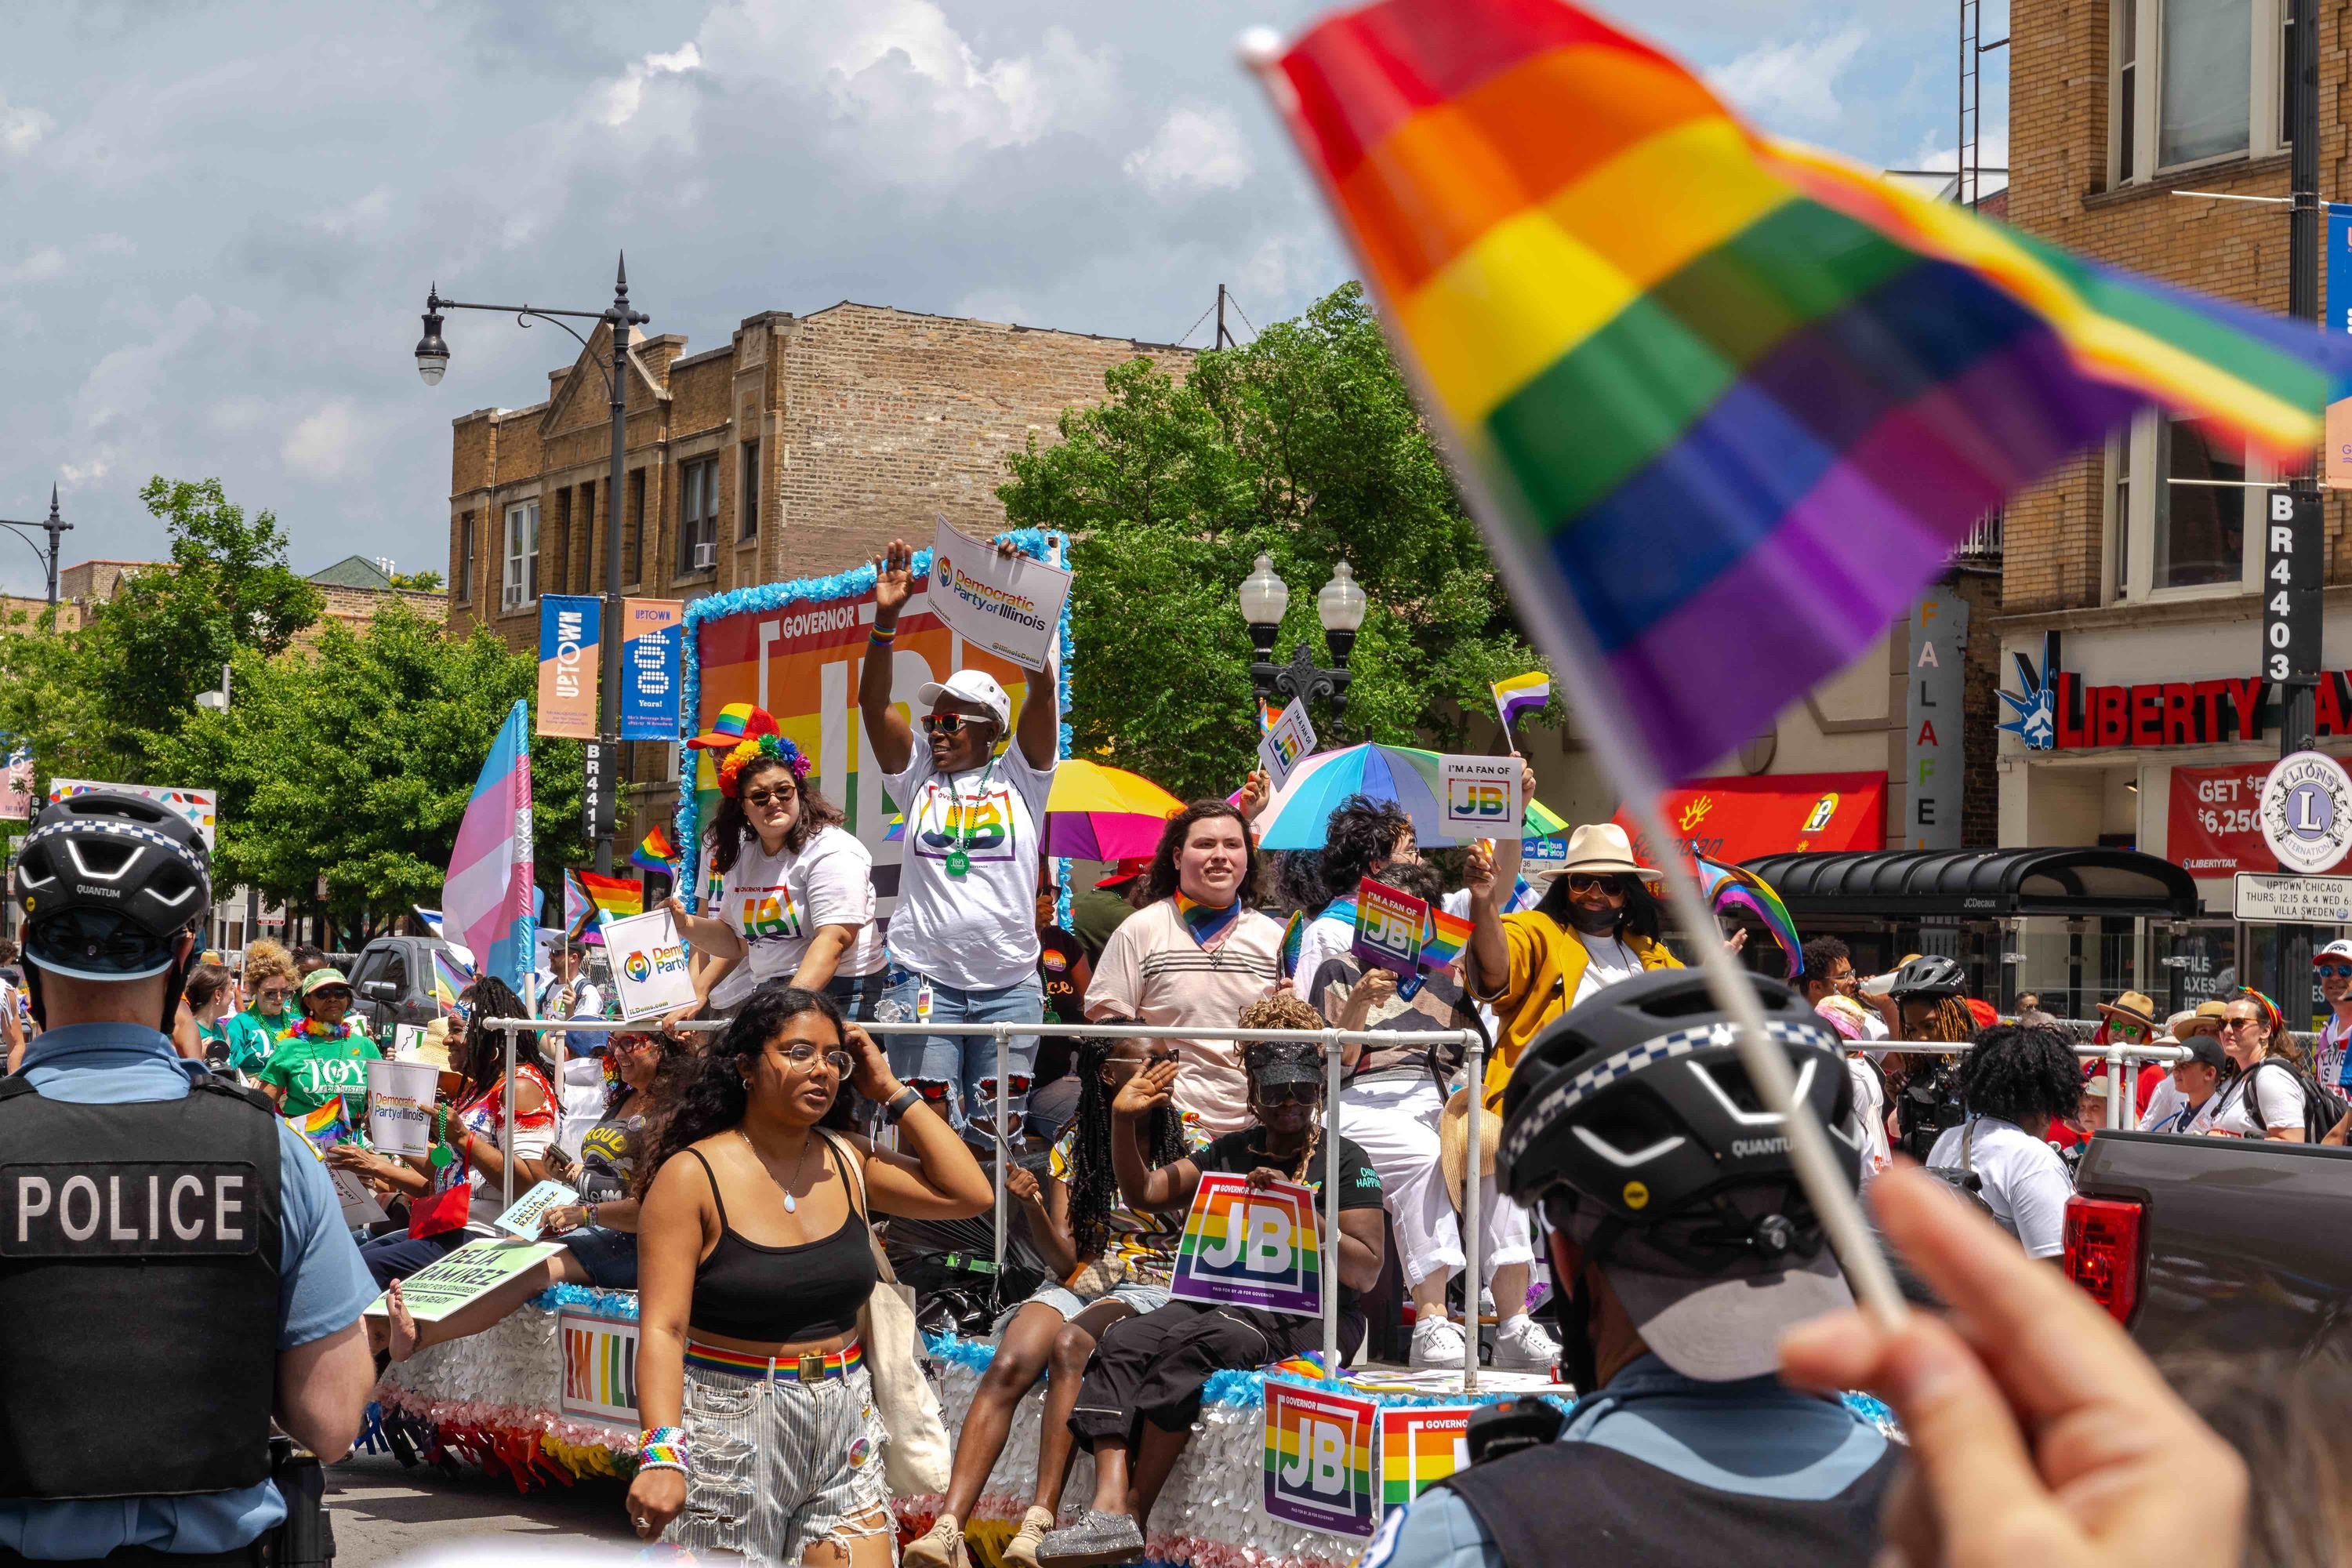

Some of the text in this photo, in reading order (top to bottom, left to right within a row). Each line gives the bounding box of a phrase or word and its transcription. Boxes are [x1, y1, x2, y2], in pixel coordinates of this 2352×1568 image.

[956, 569, 1035, 612] Democratic
[2270, 494, 2294, 680] BR4403
[635, 609, 670, 621] UPTOWN
[953, 583, 1046, 631] Party of Illinois
[782, 604, 855, 640] GOVERNOR
[556, 611, 583, 698] UPTOWN
[638, 699, 662, 708] Years!
[2056, 673, 2263, 749] LIBERTY
[1273, 732, 1298, 767] JB
[1448, 764, 1511, 775] I'M A FAN OF
[2288, 763, 2337, 788] LIONS
[586, 744, 600, 837] BR4411
[1454, 786, 1504, 815] JB
[2198, 779, 2241, 803] GET
[2298, 790, 2323, 832] L
[921, 801, 1006, 850] JB
[1550, 841, 1563, 850] bus
[2191, 858, 2238, 868] LIBERTYTAX
[76, 884, 120, 898] QUANTUM
[2267, 880, 2343, 893] UPTOWN CHICAGO
[1367, 891, 1381, 903] I'M
[1388, 901, 1405, 913] FAN
[1406, 907, 1417, 917] OF
[1963, 898, 1996, 908] JCDecaux
[2245, 892, 2276, 902] THURS:
[2280, 894, 2299, 903] 12:15
[2302, 895, 2309, 904] &
[2322, 896, 2340, 905] WED
[2274, 906, 2335, 917] VILLA SWEDEN
[1367, 915, 1409, 950] JB
[655, 957, 684, 974] Party
[376, 1093, 416, 1108] Democratic
[375, 1105, 397, 1120] Party
[402, 1109, 424, 1121] Illinois
[1732, 1136, 1795, 1159] QUANTU
[336, 1181, 344, 1190] WE
[343, 1191, 355, 1200] SAY
[1220, 1184, 1249, 1195] GOVERNOR
[19, 1175, 243, 1241] POLICE
[513, 1200, 539, 1224] DELIA
[519, 1191, 557, 1227] RAMIREZ
[522, 1195, 535, 1207] FAN
[1202, 1202, 1292, 1274] JB
[441, 1249, 506, 1267] DELIA
[412, 1265, 508, 1287] RAMIREZ
[443, 1284, 479, 1294] CONGRESS
[1285, 1396, 1316, 1410] GOVERNOR
[1425, 1419, 1469, 1429] GOVERNO
[1282, 1417, 1345, 1495] JB
